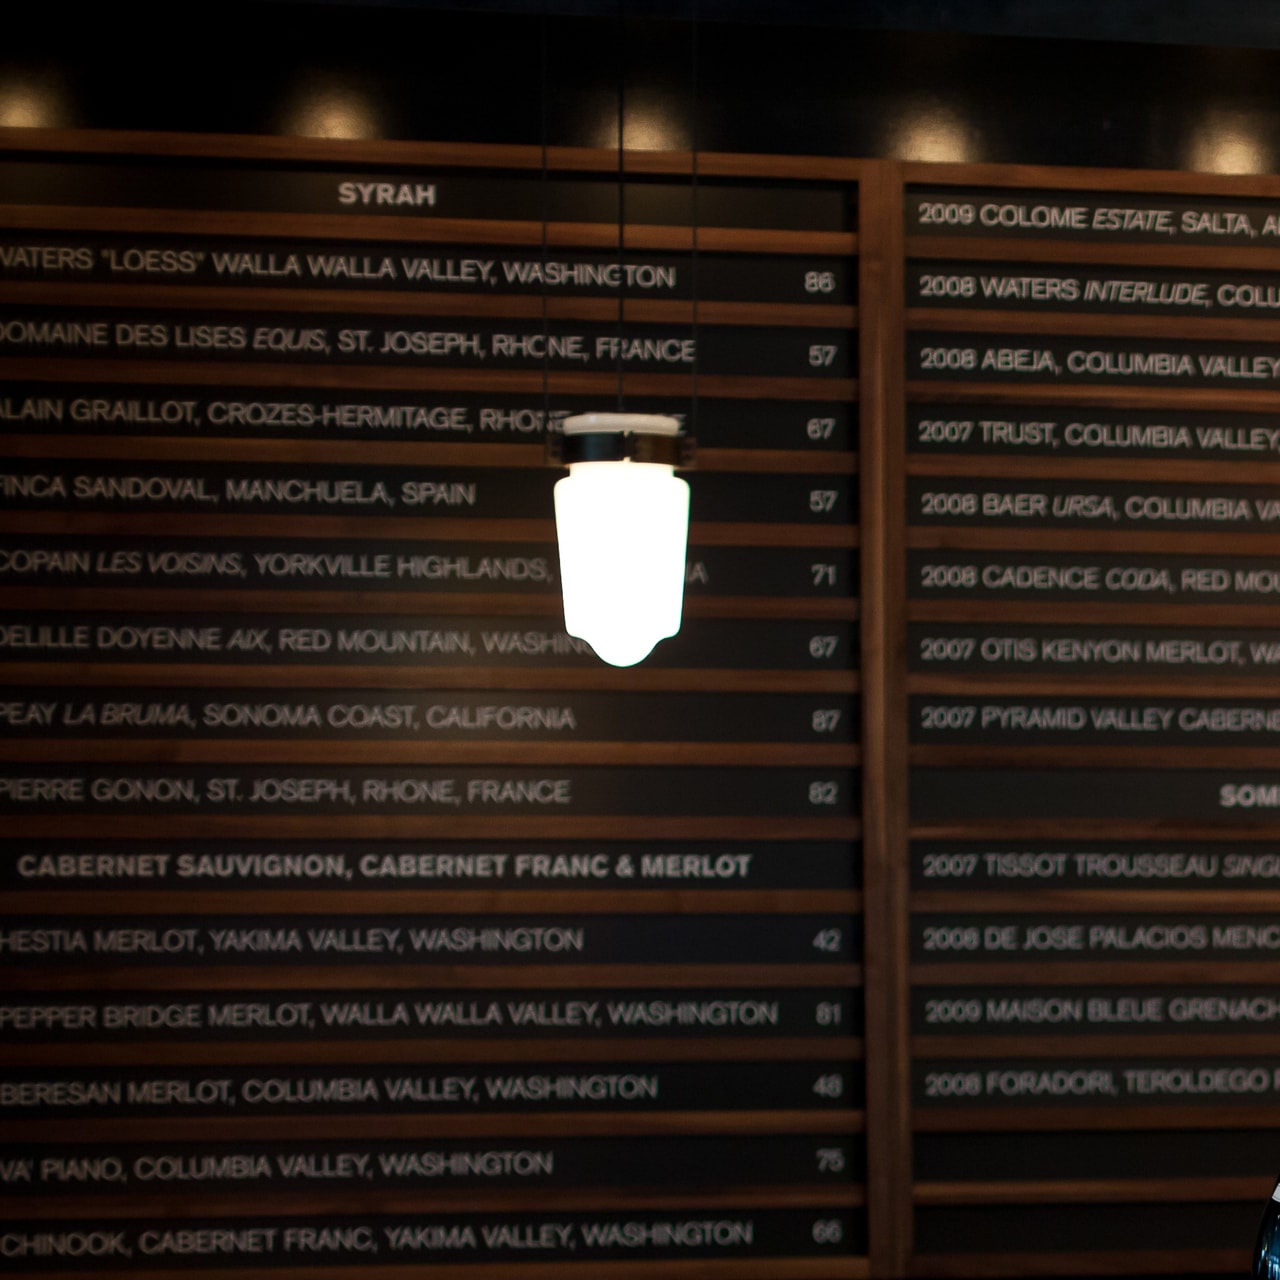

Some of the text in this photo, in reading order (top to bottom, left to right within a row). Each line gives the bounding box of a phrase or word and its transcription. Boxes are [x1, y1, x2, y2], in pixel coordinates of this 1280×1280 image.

[337, 182, 436, 204] SYRAH
[918, 202, 1258, 239] 2009 COLOME ESTATE, SALTA,
[212, 252, 676, 287] WALLA WALLA VALLEY, WASHINGTON
[919, 275, 1213, 309] 2008 WATERS INTERLUDE,
[115, 324, 838, 366] DES LISES JOSEPH, 57
[920, 348, 978, 369] 2008
[980, 347, 1062, 376] ABEJA,
[1066, 351, 1196, 376] COLUMBIA
[70, 398, 837, 438] GRAILLOT, CROZES-HERMITAGE, 67
[918, 421, 974, 442] 2007
[978, 421, 1060, 449] TRUST,
[1064, 423, 1193, 448] COLUMBIA
[74, 477, 839, 512] SANDOVAL, MANCHUELA, SPAIN 57
[921, 493, 1253, 522] 2008 BAER URSA, COLUMBIA
[96, 551, 142, 573] LES
[254, 553, 393, 577] YORKVILLE
[396, 556, 554, 586] HIGHLANDS,
[810, 564, 837, 584] 71
[920, 566, 979, 586] 2008
[981, 565, 1101, 589] CADENCE
[1104, 568, 1177, 594] CODA,
[1180, 569, 1234, 592] RED
[97, 626, 839, 658] DOYENNE RED MOUNTAIN, 67
[920, 639, 974, 659] 2007
[980, 638, 1037, 661] OTIS
[1041, 640, 1141, 662] KENYON
[1145, 641, 1246, 668] MERLOT,
[63, 704, 96, 728] LA
[203, 704, 322, 729] SONOMA
[327, 704, 421, 731] COAST,
[424, 704, 577, 730] CALIFORNIA
[811, 710, 842, 732] 87
[921, 707, 975, 728] 2007
[981, 707, 1086, 728] PYRAMID
[1090, 708, 1173, 730] VALLEY
[249, 778, 355, 806] JOSEPH,
[363, 779, 461, 808] RHONE,
[467, 779, 569, 803] FRANCE
[18, 854, 752, 880] CABERNET SAUVIGNON, CABERNET FRANC & MERLOT
[923, 855, 979, 876] 2007
[984, 854, 1068, 876] TISSOT
[1073, 854, 1219, 877] TROUSSEAU
[93, 928, 843, 956] MERLOT, YAKIMA VALLEY, WASHINGTON 42
[103, 1001, 780, 1030] BRIDGE MERLOT, WALLA WALLA VALLEY, WASHINGTON
[986, 999, 1083, 1020] MAISON
[1087, 999, 1163, 1021] BLEUE
